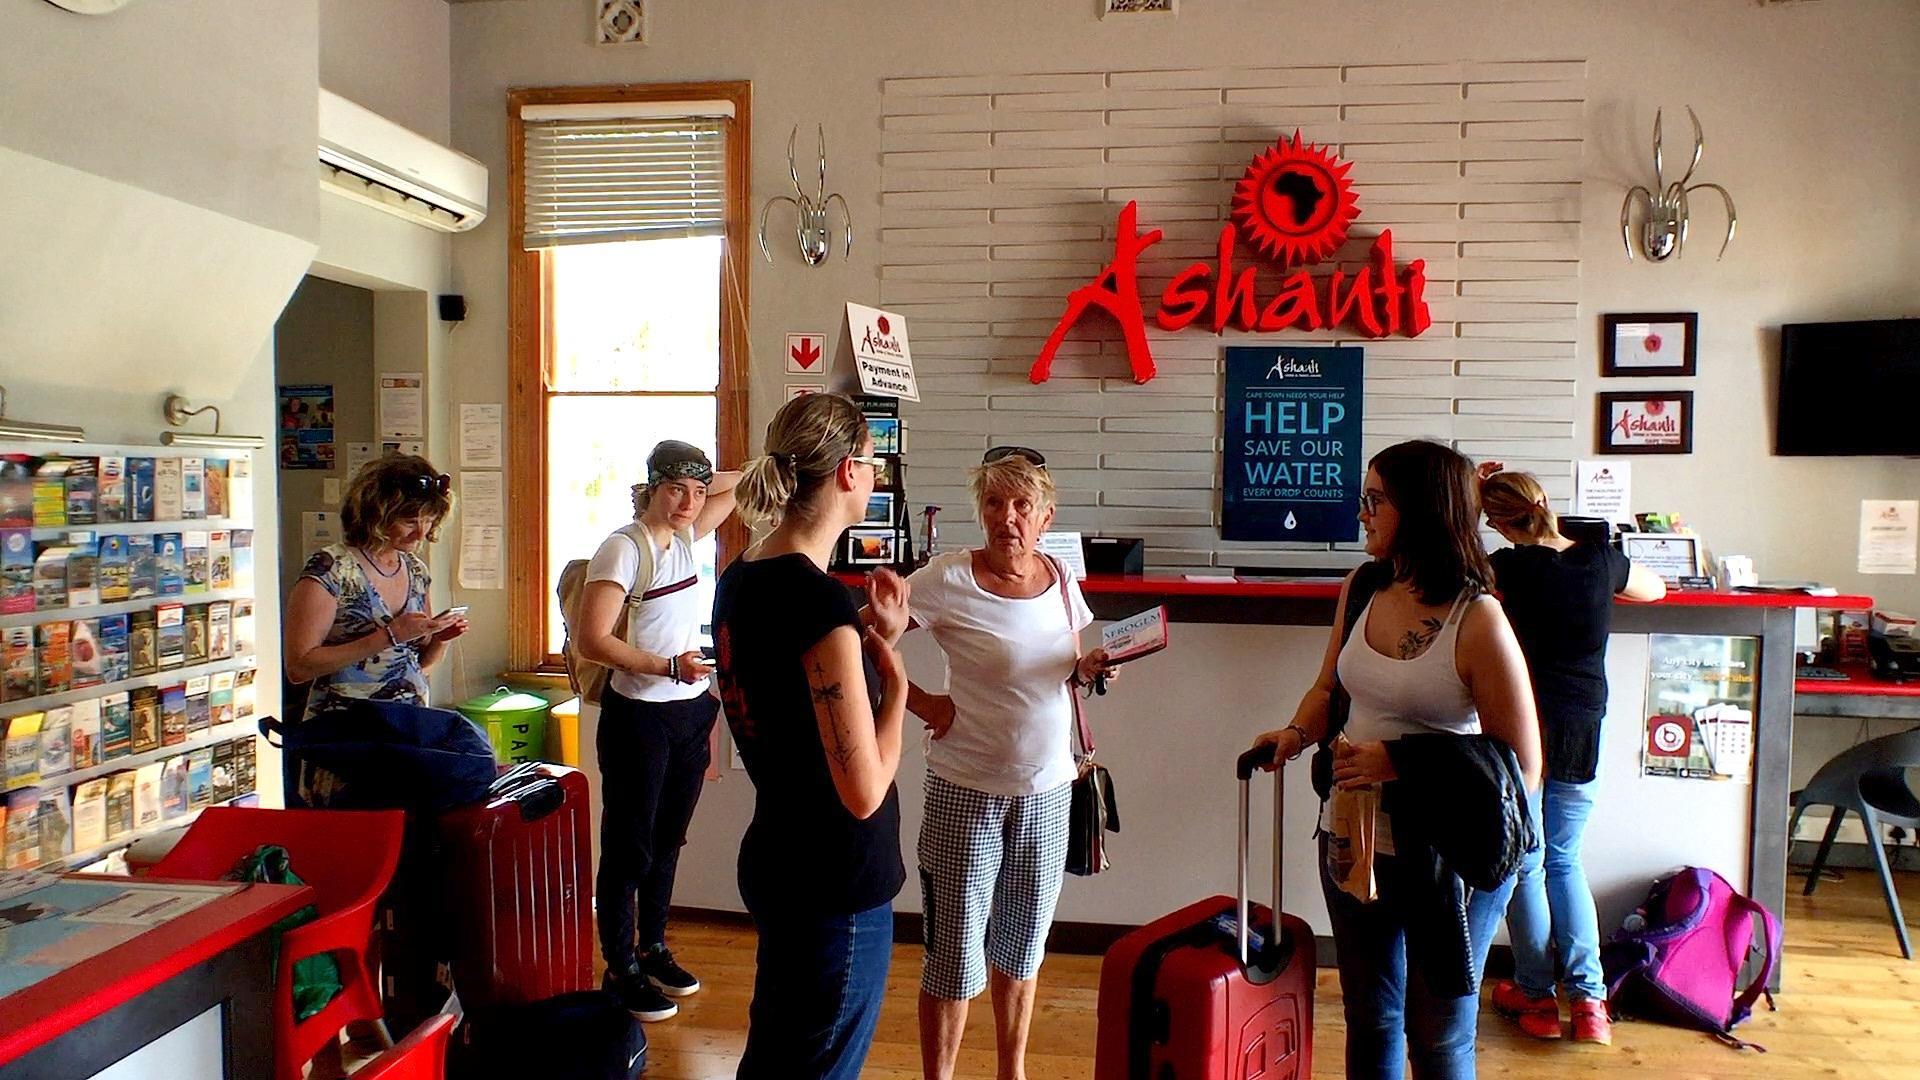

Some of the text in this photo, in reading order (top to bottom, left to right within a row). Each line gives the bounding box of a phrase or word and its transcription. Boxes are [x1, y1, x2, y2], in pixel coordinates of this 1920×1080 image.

[1029, 200, 1431, 385] Ashanti
[861, 325, 901, 354] Ashanti
[862, 361, 911, 380] Payment in
[1265, 355, 1319, 380] Ashanti
[871, 377, 908, 391] Advance
[1286, 392, 1307, 400] NEEDS
[1308, 392, 1327, 400] YOUR
[1328, 392, 1345, 400] HELP
[1245, 401, 1345, 435] HELP
[1612, 409, 1675, 439] Ashanti
[1244, 440, 1344, 457] SAVE OUR
[1244, 462, 1343, 486] WATER
[1243, 488, 1344, 499] EVERY DROP COUNTS
